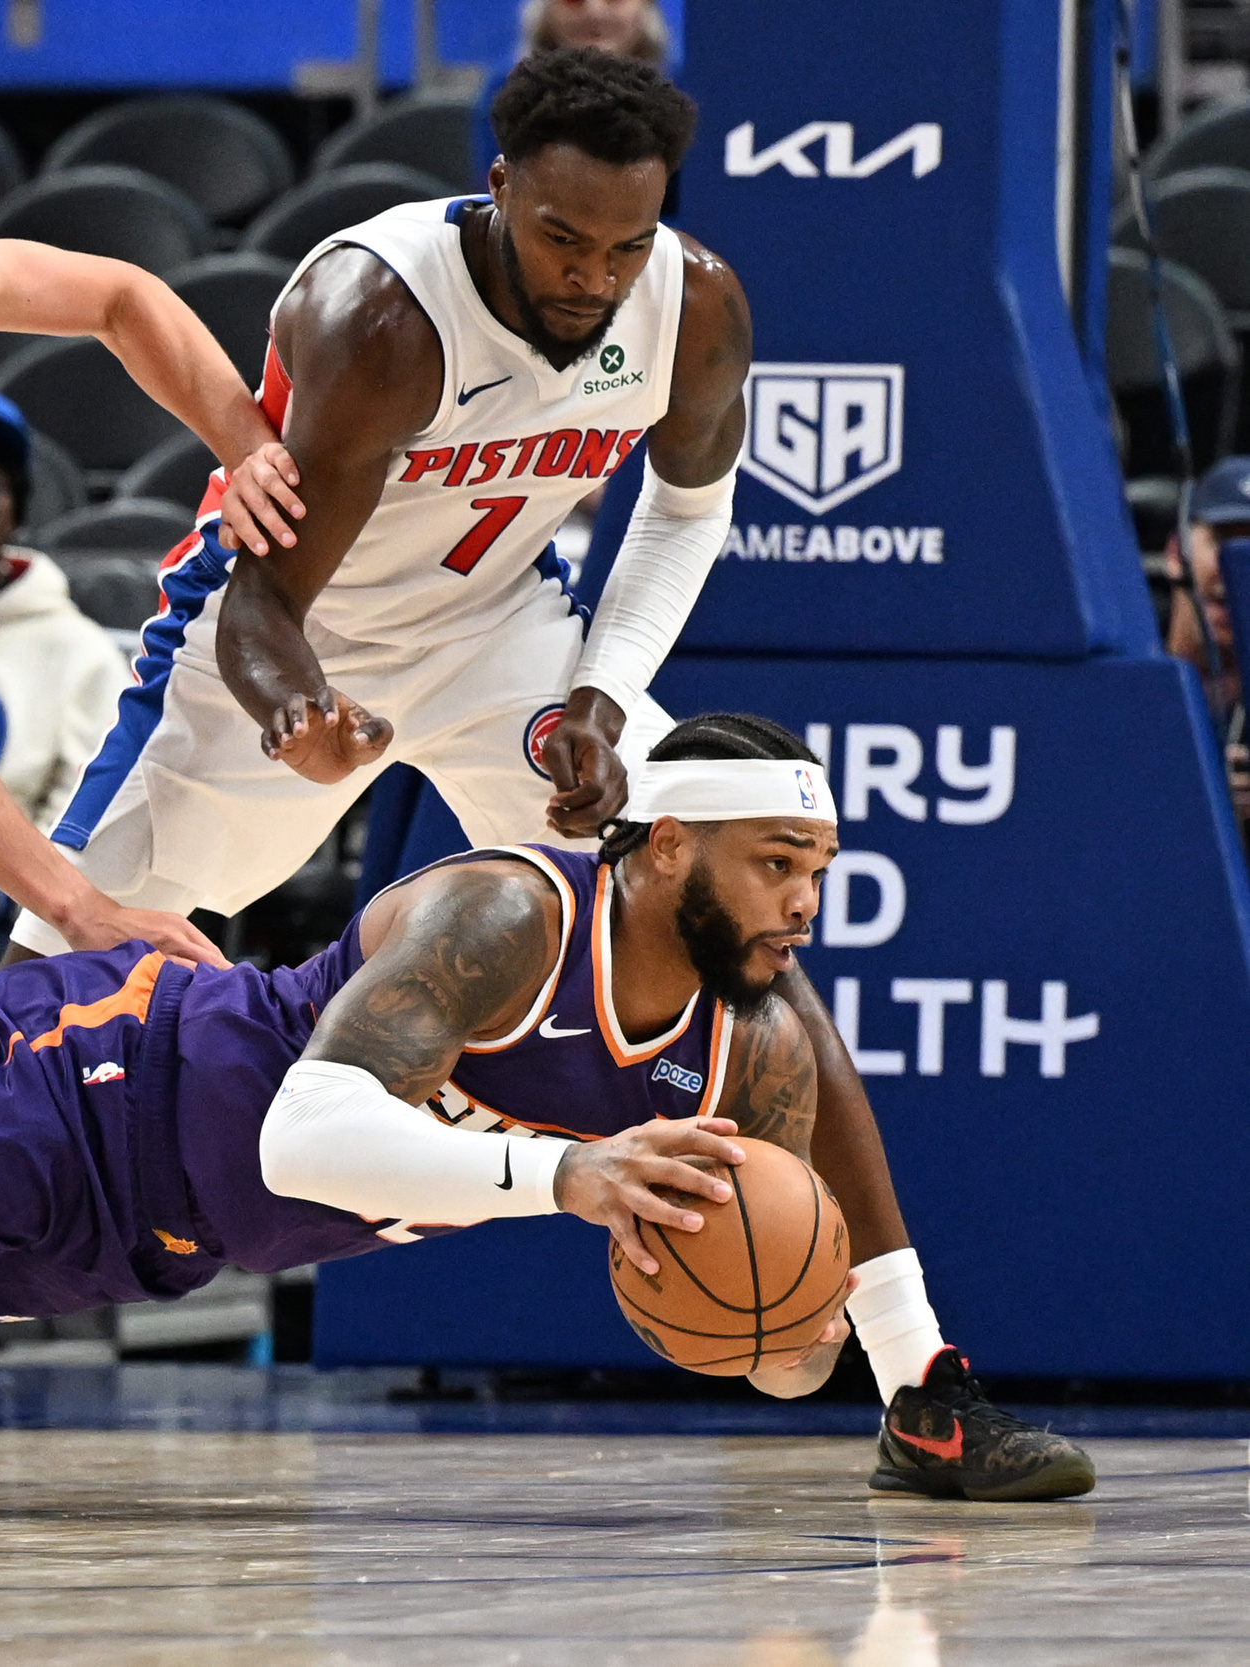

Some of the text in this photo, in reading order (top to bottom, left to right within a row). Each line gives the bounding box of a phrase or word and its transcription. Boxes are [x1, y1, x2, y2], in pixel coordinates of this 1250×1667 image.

[583, 371, 644, 395] StockX
[398, 428, 644, 487] PISTONS
[754, 379, 890, 494] GA
[440, 496, 529, 577] 7
[718, 523, 945, 564] AMEABOVE
[805, 722, 1017, 826] RY
[652, 1059, 703, 1092] paze
